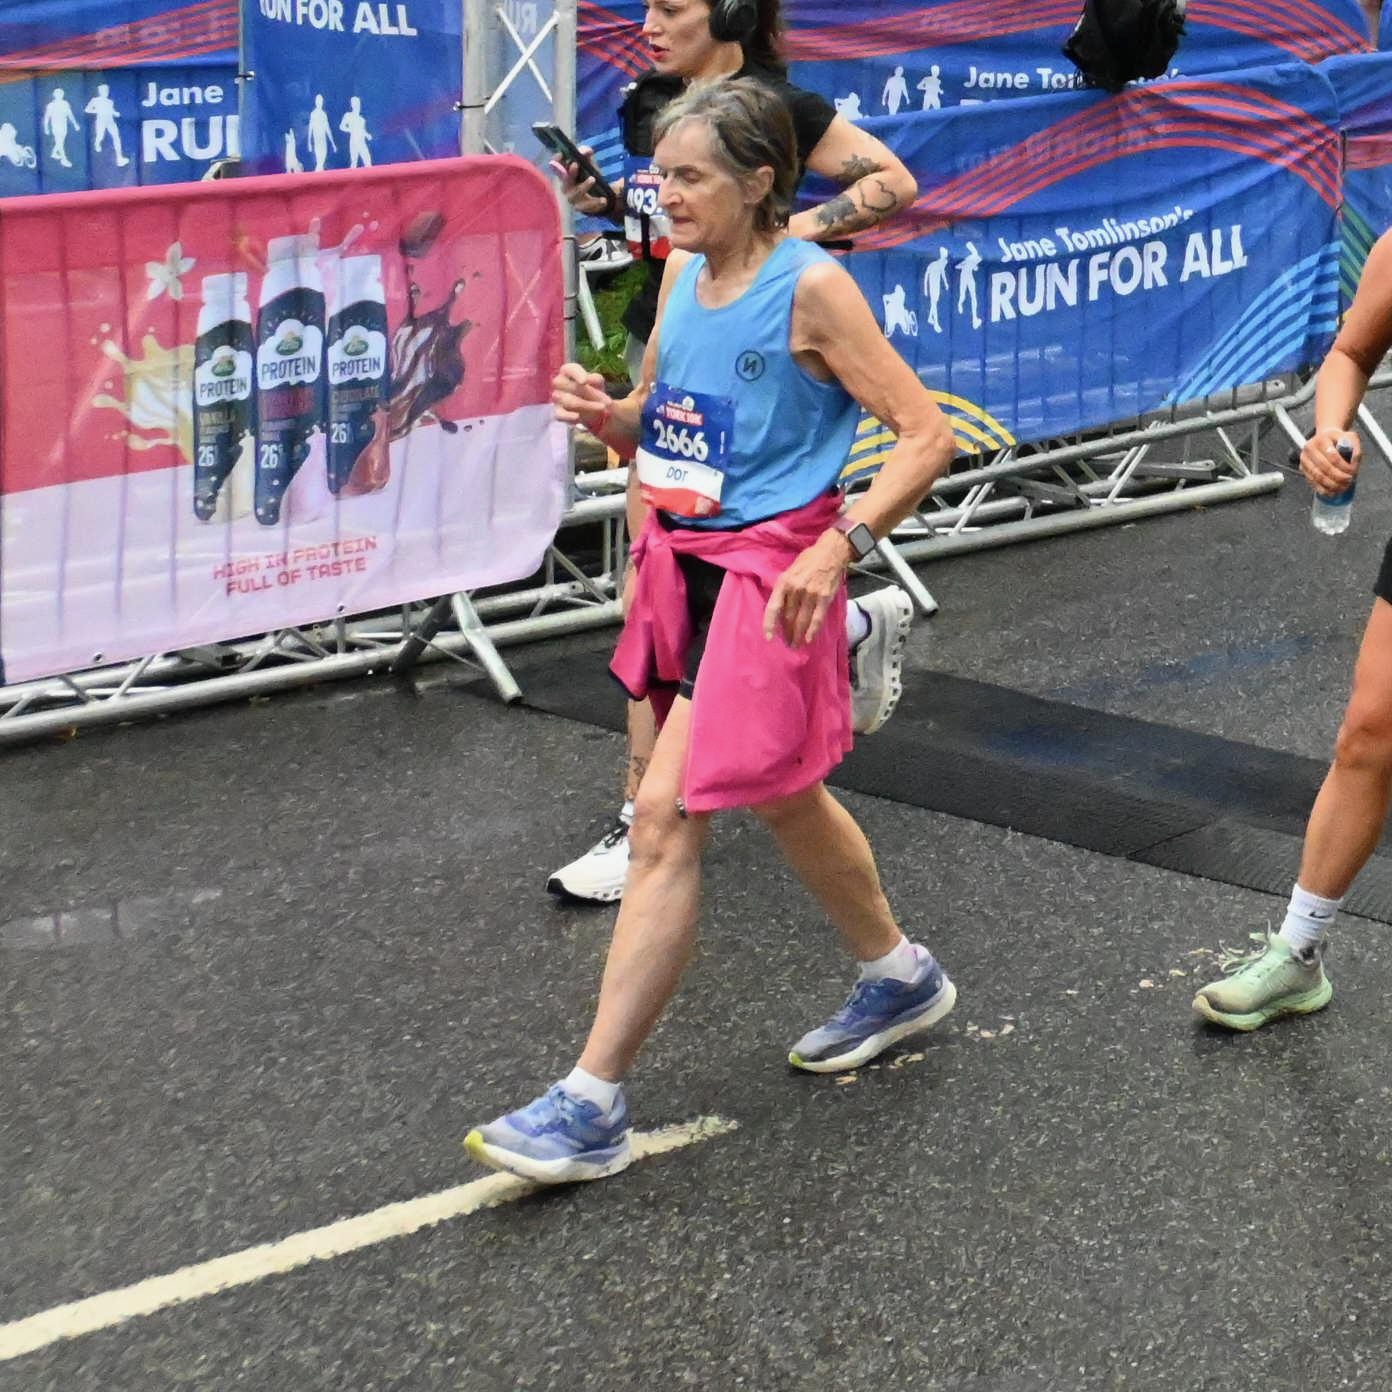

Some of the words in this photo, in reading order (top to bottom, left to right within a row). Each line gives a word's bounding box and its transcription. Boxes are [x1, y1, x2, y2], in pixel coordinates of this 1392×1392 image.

[352, 1, 417, 36] ALL
[963, 66, 1031, 90] Jane
[141, 82, 224, 107] Jane
[998, 236, 1056, 264] Jane
[1059, 205, 1193, 254] Tomlinson's
[990, 256, 1077, 323] RUN
[1088, 239, 1168, 302] FOR
[1180, 224, 1248, 283] ALL
[261, 356, 316, 381] PROTEIN
[331, 357, 381, 377] PROTEIN
[199, 376, 248, 398] PROTEIN
[653, 419, 709, 462] 2666
[666, 466, 688, 482] DOT
[213, 559, 260, 580] HIGH
[265, 552, 288, 569] IN
[293, 535, 377, 561] PROTEIN
[225, 575, 273, 597] FULL
[277, 570, 302, 587] OF
[305, 556, 367, 580] TASTE
